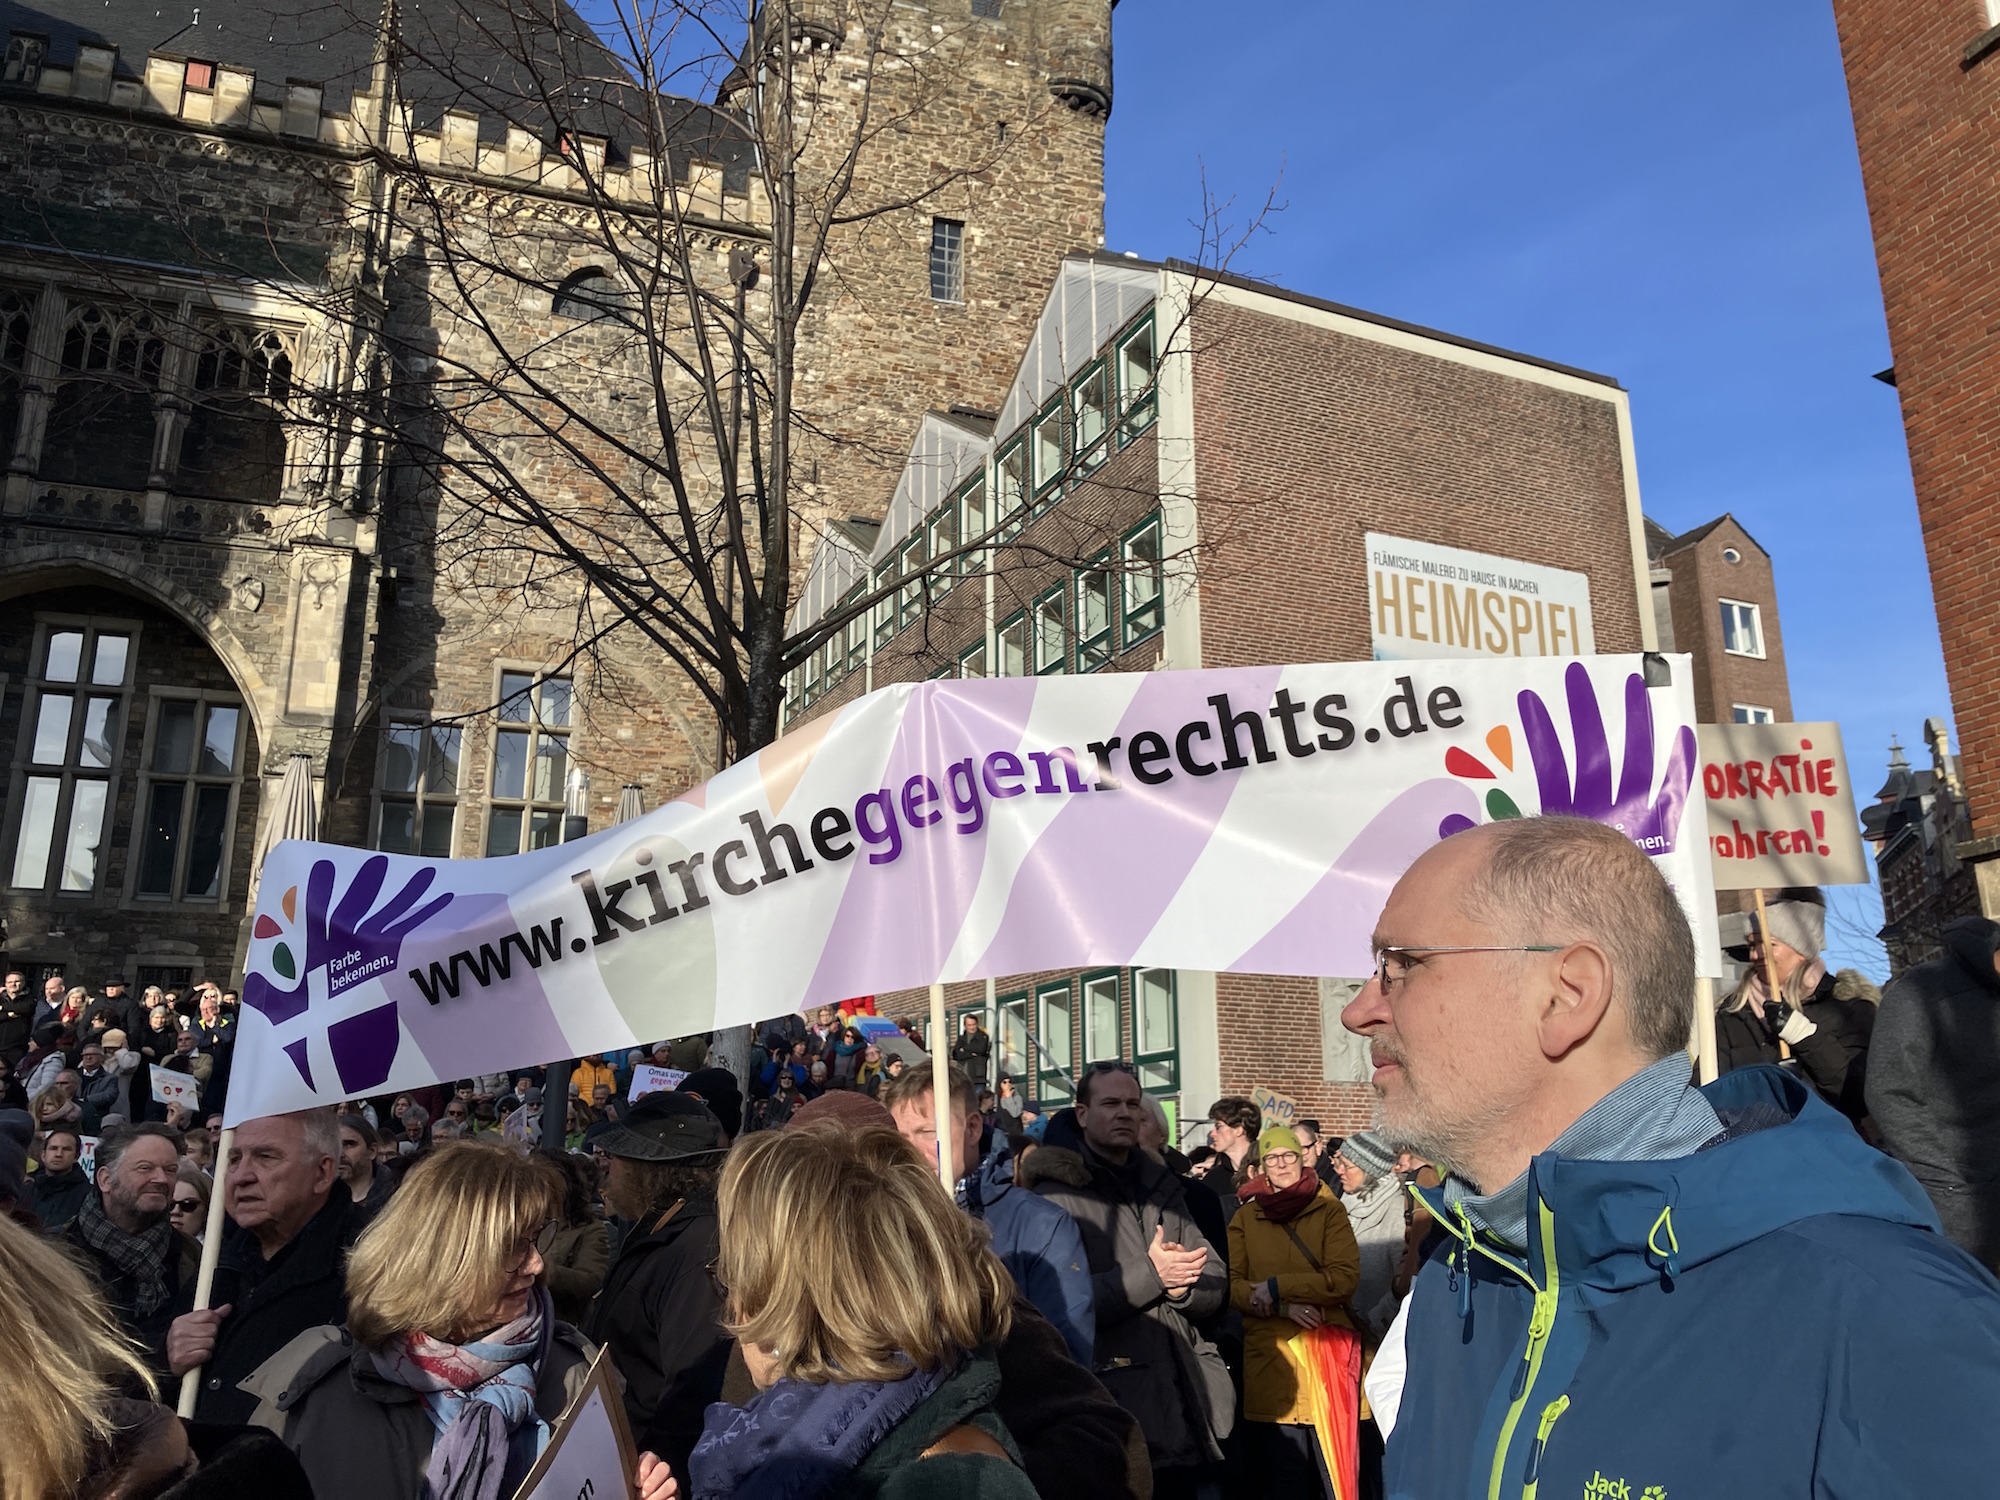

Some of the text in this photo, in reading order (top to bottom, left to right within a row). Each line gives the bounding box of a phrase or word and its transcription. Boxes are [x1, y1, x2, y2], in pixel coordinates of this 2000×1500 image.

[1374, 550, 1539, 594] FLÄMISCHE MALEREI ZU HAUSE IN AACHEN
[409, 675, 1465, 1006] www.kirchegegenrechts.de
[1709, 809, 1831, 860] ahren!
[330, 950, 362, 974] Farbe
[331, 955, 395, 991] bekennen.
[648, 1068, 684, 1080] Omas und
[649, 1077, 671, 1086] gegen
[1585, 1470, 1632, 1500] Jack
